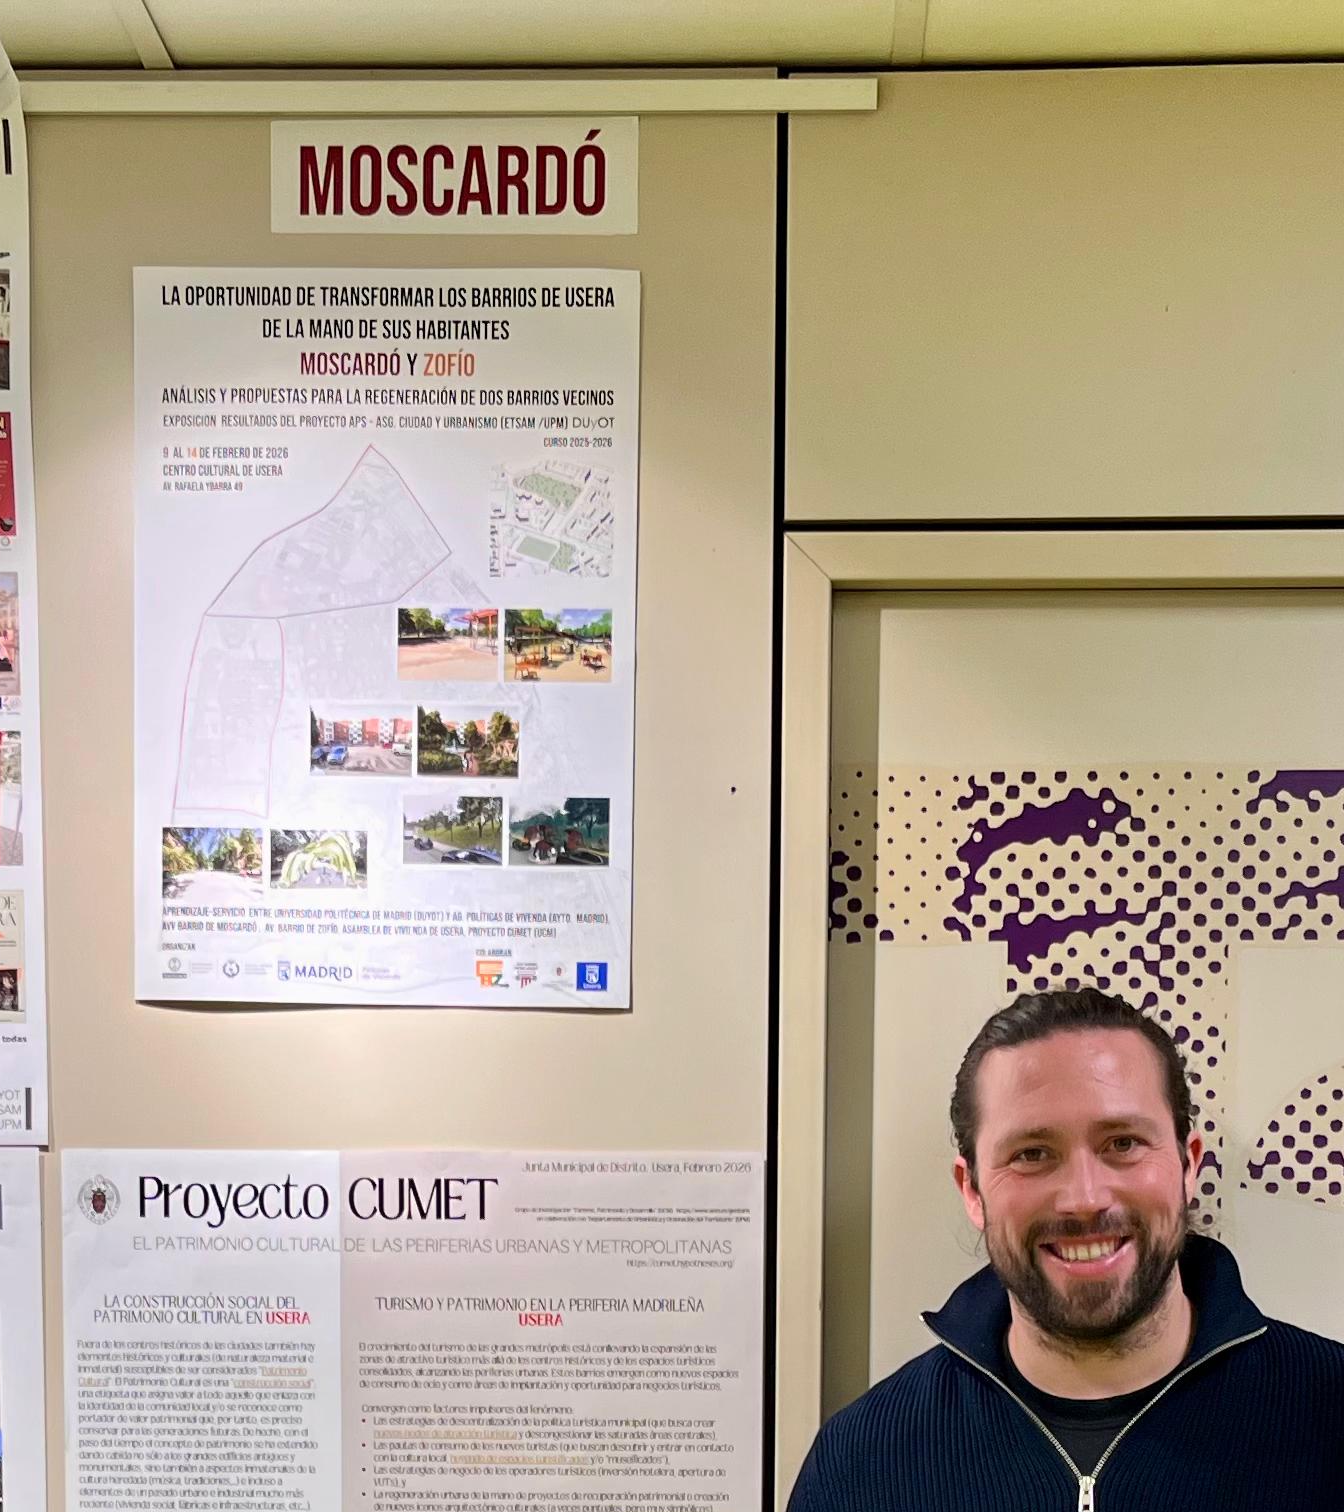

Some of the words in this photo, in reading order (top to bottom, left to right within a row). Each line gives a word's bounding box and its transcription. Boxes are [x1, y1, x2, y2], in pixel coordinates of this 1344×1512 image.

[299, 129, 608, 217] MOSCARDÓ
[162, 286, 180, 305] LA
[186, 286, 291, 306] OPORTUNIDAD
[297, 287, 315, 306] DE
[320, 287, 433, 307] TRANSFORMAR
[439, 288, 466, 307] LOS
[472, 288, 536, 307] BARRIOS
[542, 288, 560, 307] DE
[566, 287, 614, 307] USERA
[263, 319, 281, 337] DE
[287, 319, 304, 338] LA
[310, 319, 353, 338] MANO
[359, 319, 377, 338] DE
[383, 320, 411, 339] SUS
[417, 320, 509, 340] HABITANTES
[301, 348, 400, 375] MOSCARDÓ
[407, 353, 417, 376] Y
[424, 349, 474, 376] ZOFÍO
[162, 386, 215, 403] ANÁLISIS
[220, 388, 226, 402] Y
[231, 388, 307, 403] PROPUESTAS
[312, 389, 342, 404] PARA
[347, 389, 361, 404] LA
[365, 388, 456, 405] REGENERACIÓN
[461, 390, 475, 405] DE
[480, 390, 503, 405] DOS
[508, 390, 559, 405] BARRIOS
[563, 390, 614, 406] VECINOS
[163, 447, 168, 458] 9
[173, 447, 183, 458] AL
[188, 448, 197, 460] 14
[200, 447, 210, 460] DE
[212, 447, 250, 461] FEBRERO
[253, 447, 263, 460] DE
[265, 447, 288, 461] 2026
[163, 464, 196, 477] CENTRO
[199, 465, 240, 476] CULTURAL
[243, 465, 253, 476] DE
[256, 465, 282, 476] USERA
[295, 966, 352, 981] MADRID
[139, 1175, 328, 1228] Proyecto
[349, 1178, 498, 1220] CUMET
[133, 1236, 152, 1250] EL
[156, 1235, 253, 1251] PATRIMONIO
[256, 1235, 340, 1254] CULTURAL
[344, 1237, 365, 1252] DE
[372, 1238, 404, 1254] LAS
[406, 1238, 494, 1254] PERIFERIAS
[496, 1239, 569, 1254] URBANAS
[573, 1240, 584, 1252] Y
[586, 1240, 732, 1256] METROPOLITANAS
[104, 1295, 120, 1309] LA
[123, 1292, 225, 1309] CONSTRUCCIÓN
[228, 1296, 273, 1309] SOCIAL
[277, 1296, 299, 1309] DEL
[375, 1297, 433, 1311] TURISMO
[437, 1298, 443, 1310] Y
[447, 1298, 527, 1312] PATRIMONIO
[530, 1298, 546, 1312] EN
[550, 1298, 565, 1312] LA
[569, 1298, 629, 1312] PERIFERIA
[633, 1296, 704, 1312] MADRILEÑA
[94, 1311, 173, 1323] PATRIMONIO
[177, 1311, 242, 1324] CULTURAL
[247, 1311, 262, 1324] EN
[266, 1312, 310, 1325] USERA
[519, 1314, 563, 1326] USERA
